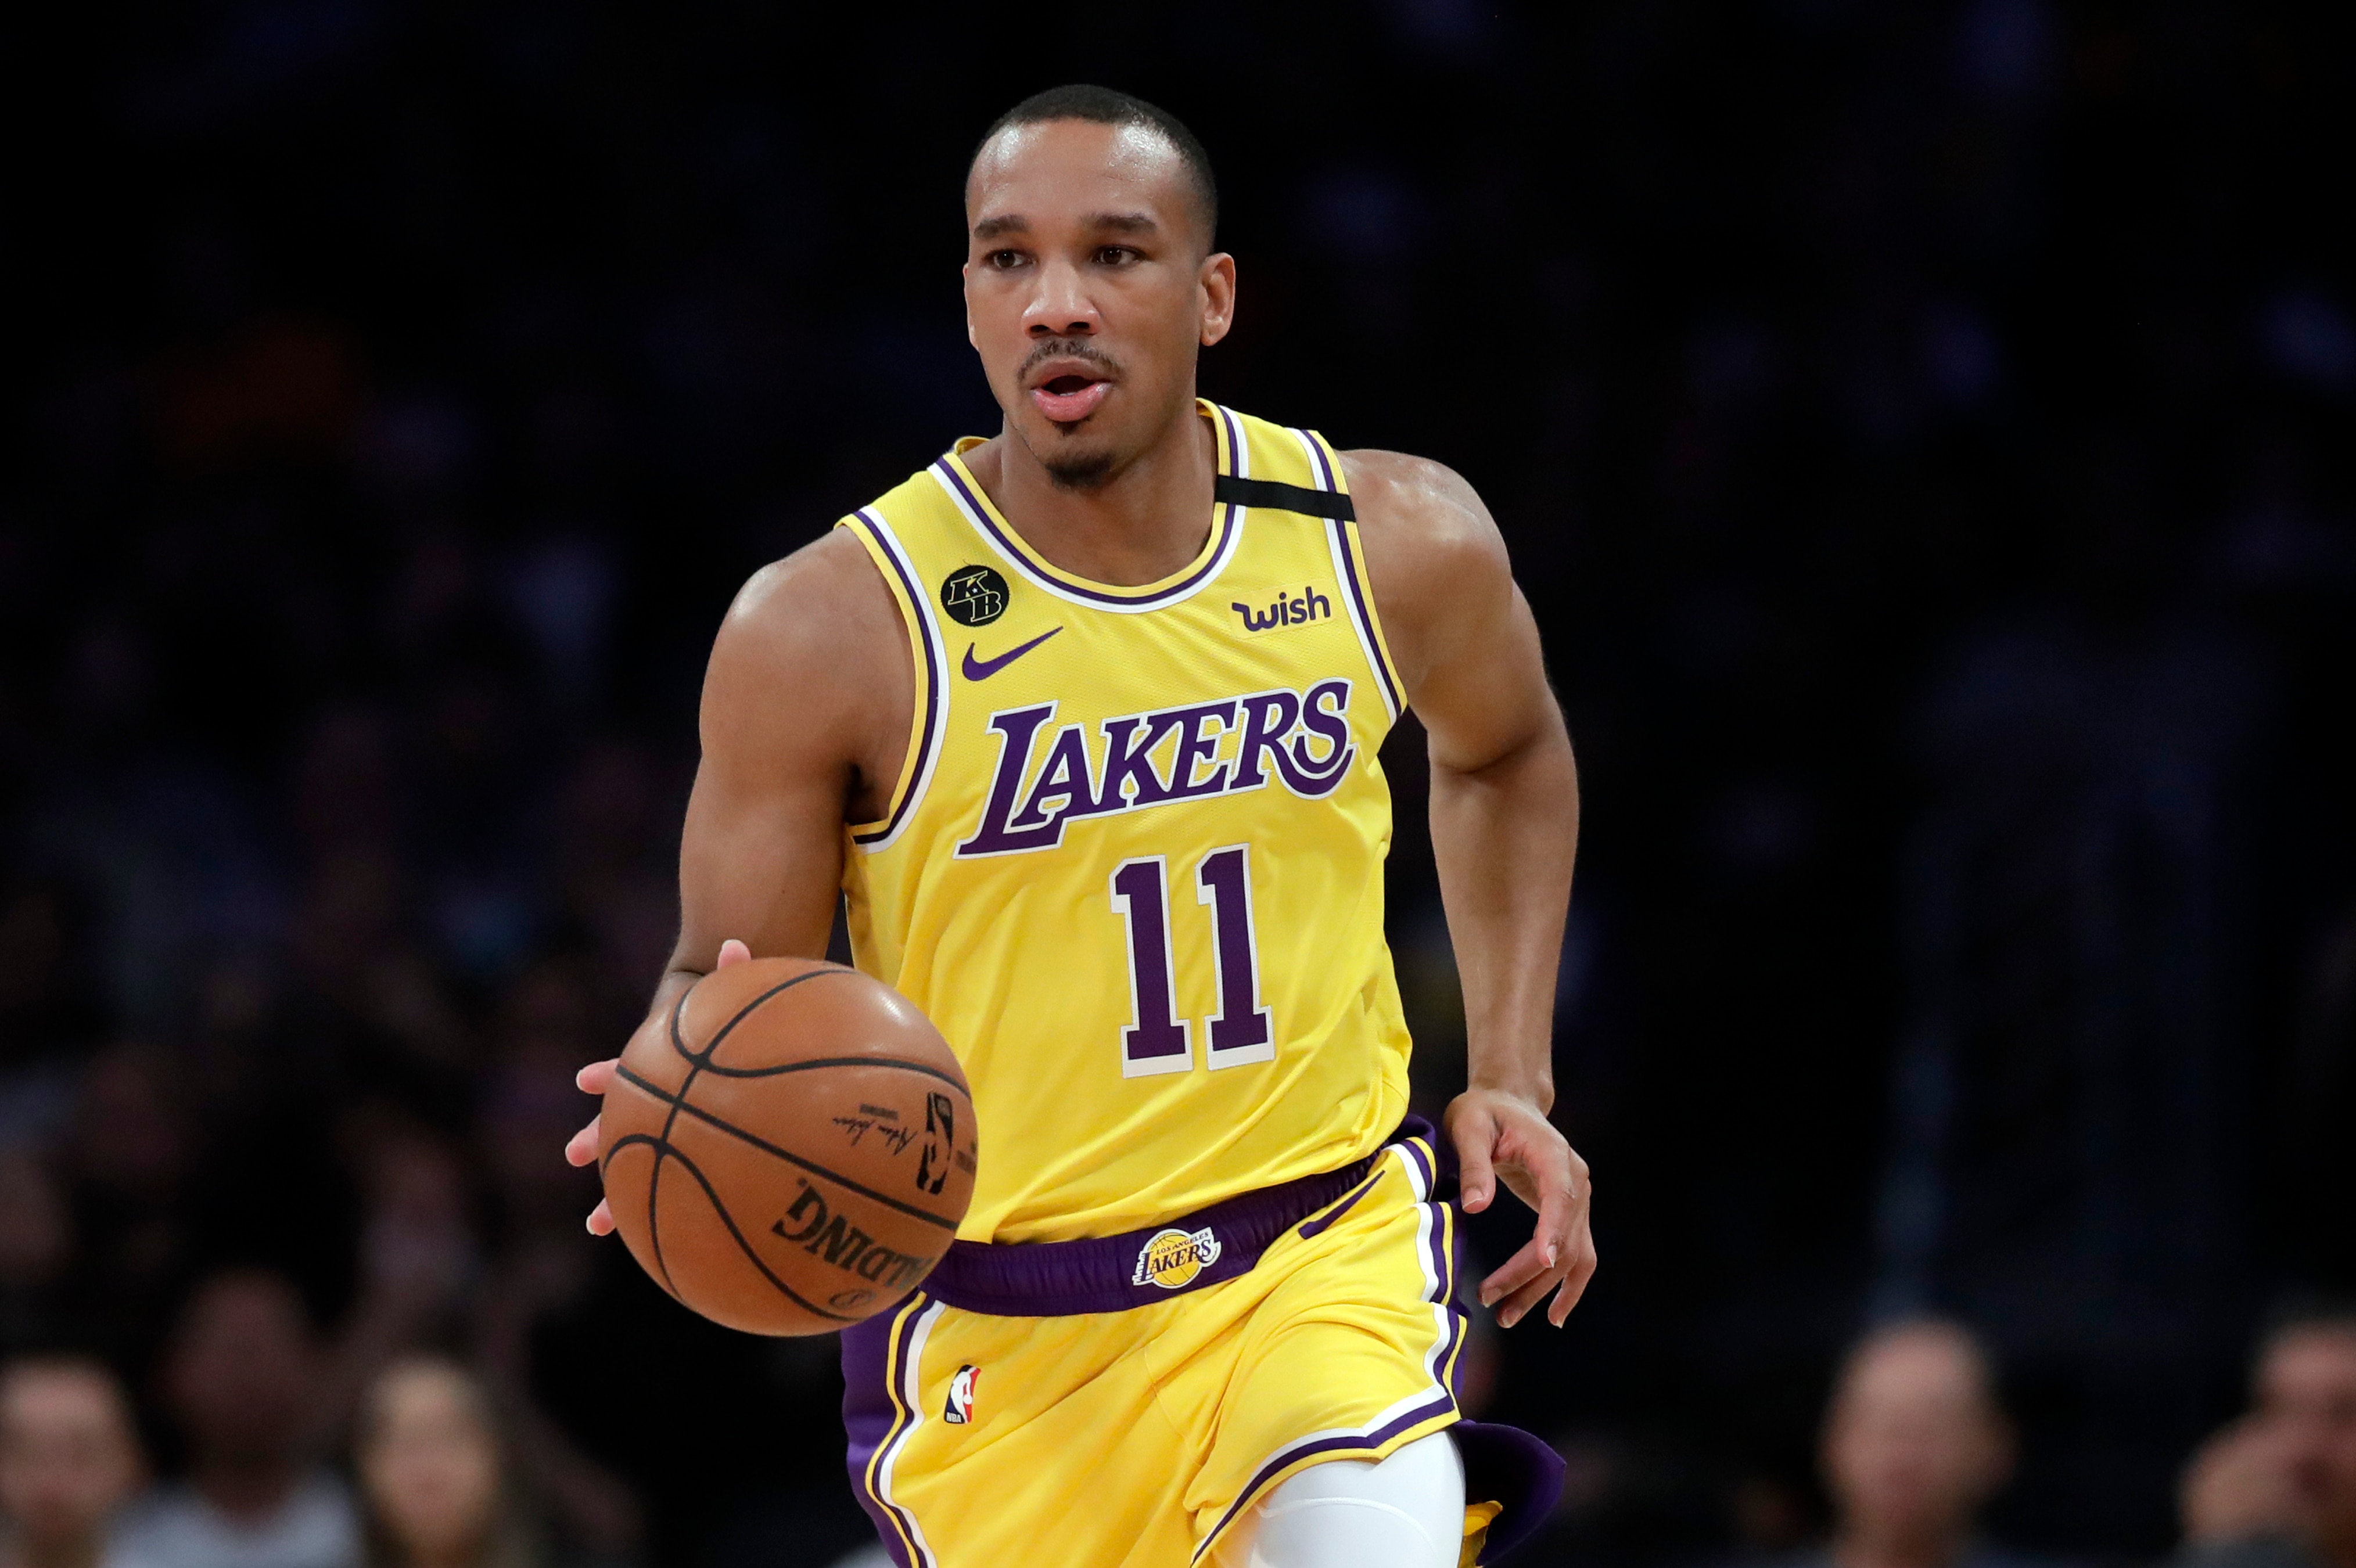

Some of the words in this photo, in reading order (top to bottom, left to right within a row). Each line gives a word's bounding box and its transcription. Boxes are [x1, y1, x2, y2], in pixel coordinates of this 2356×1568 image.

[947, 570, 1002, 623] KB
[1231, 586, 1331, 632] wish
[953, 677, 1359, 859] LAKERS
[1108, 842, 1274, 1078] 11
[1136, 1239, 1217, 1283] LAKERS
[1157, 1245, 1171, 1255] LOS
[1172, 1231, 1209, 1249] ANGELES
[946, 1412, 962, 1423] NBA
